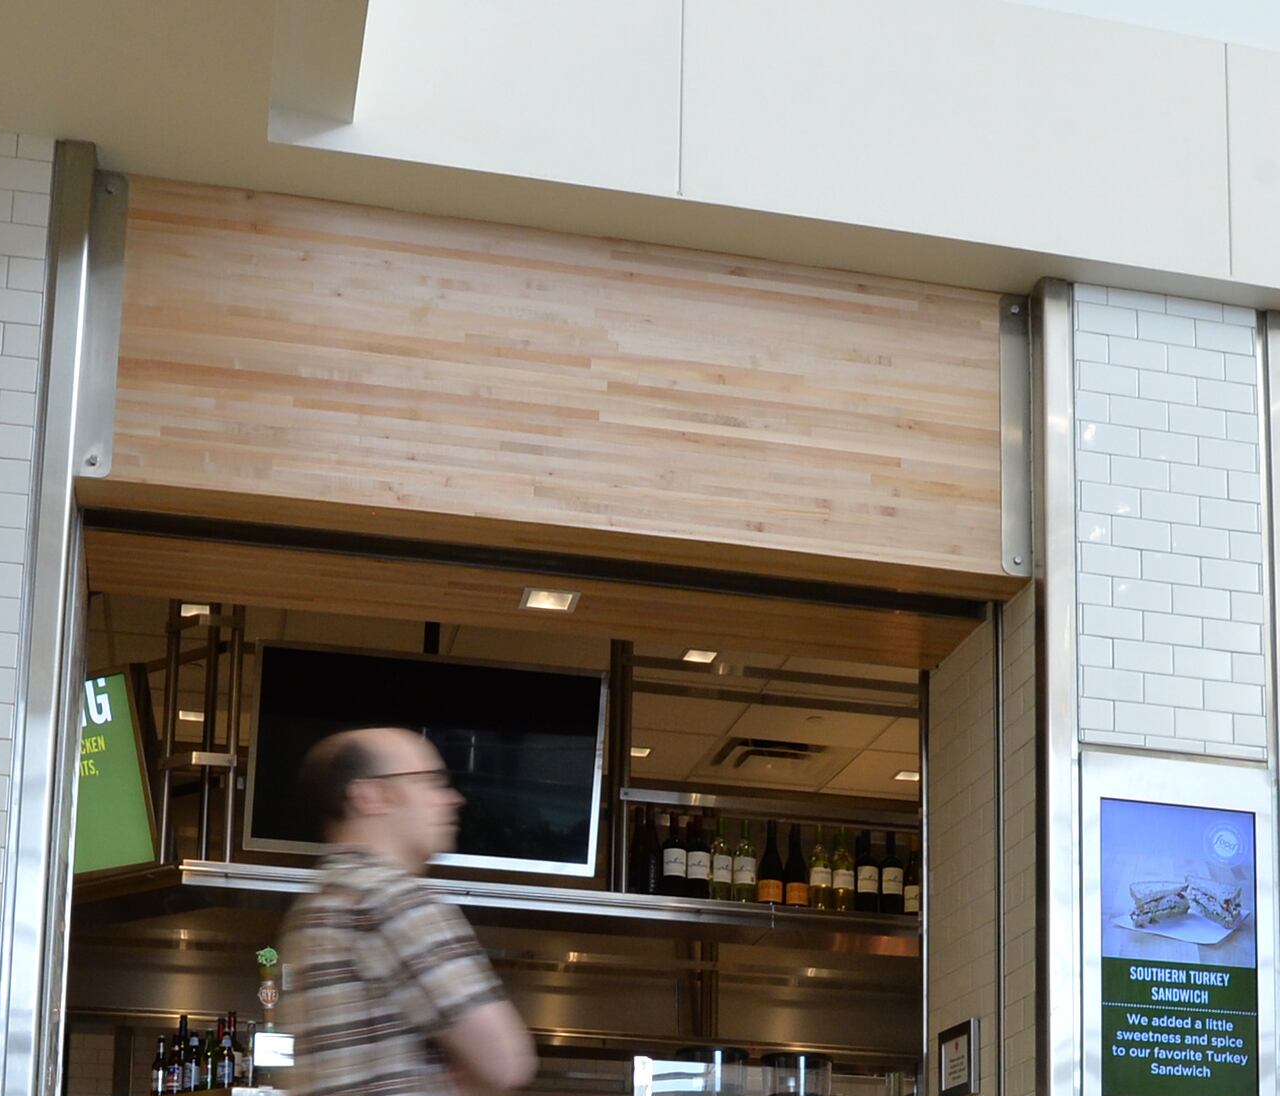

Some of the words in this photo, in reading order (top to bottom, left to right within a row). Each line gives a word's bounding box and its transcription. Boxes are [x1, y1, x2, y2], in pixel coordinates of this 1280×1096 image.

[80, 735, 106, 755] CKEN
[80, 759, 100, 777] ITS,
[1129, 966, 1187, 984] SOUTHERN
[1189, 970, 1230, 987] TURKEY
[1151, 986, 1209, 1004] SANDWICH
[1126, 1013, 1149, 1026] We
[1151, 1015, 1191, 1029] added
[1194, 1019, 1202, 1030] a
[1205, 1018, 1234, 1031] little
[1116, 1030, 1181, 1044] sweetness
[1184, 1034, 1208, 1046] and
[1211, 1036, 1244, 1048] spice
[1112, 1045, 1126, 1056] to
[1129, 1047, 1151, 1058] our
[1154, 1046, 1203, 1061] favorite
[1206, 1050, 1248, 1066] Turkey
[1151, 1062, 1211, 1077] Sandwich
